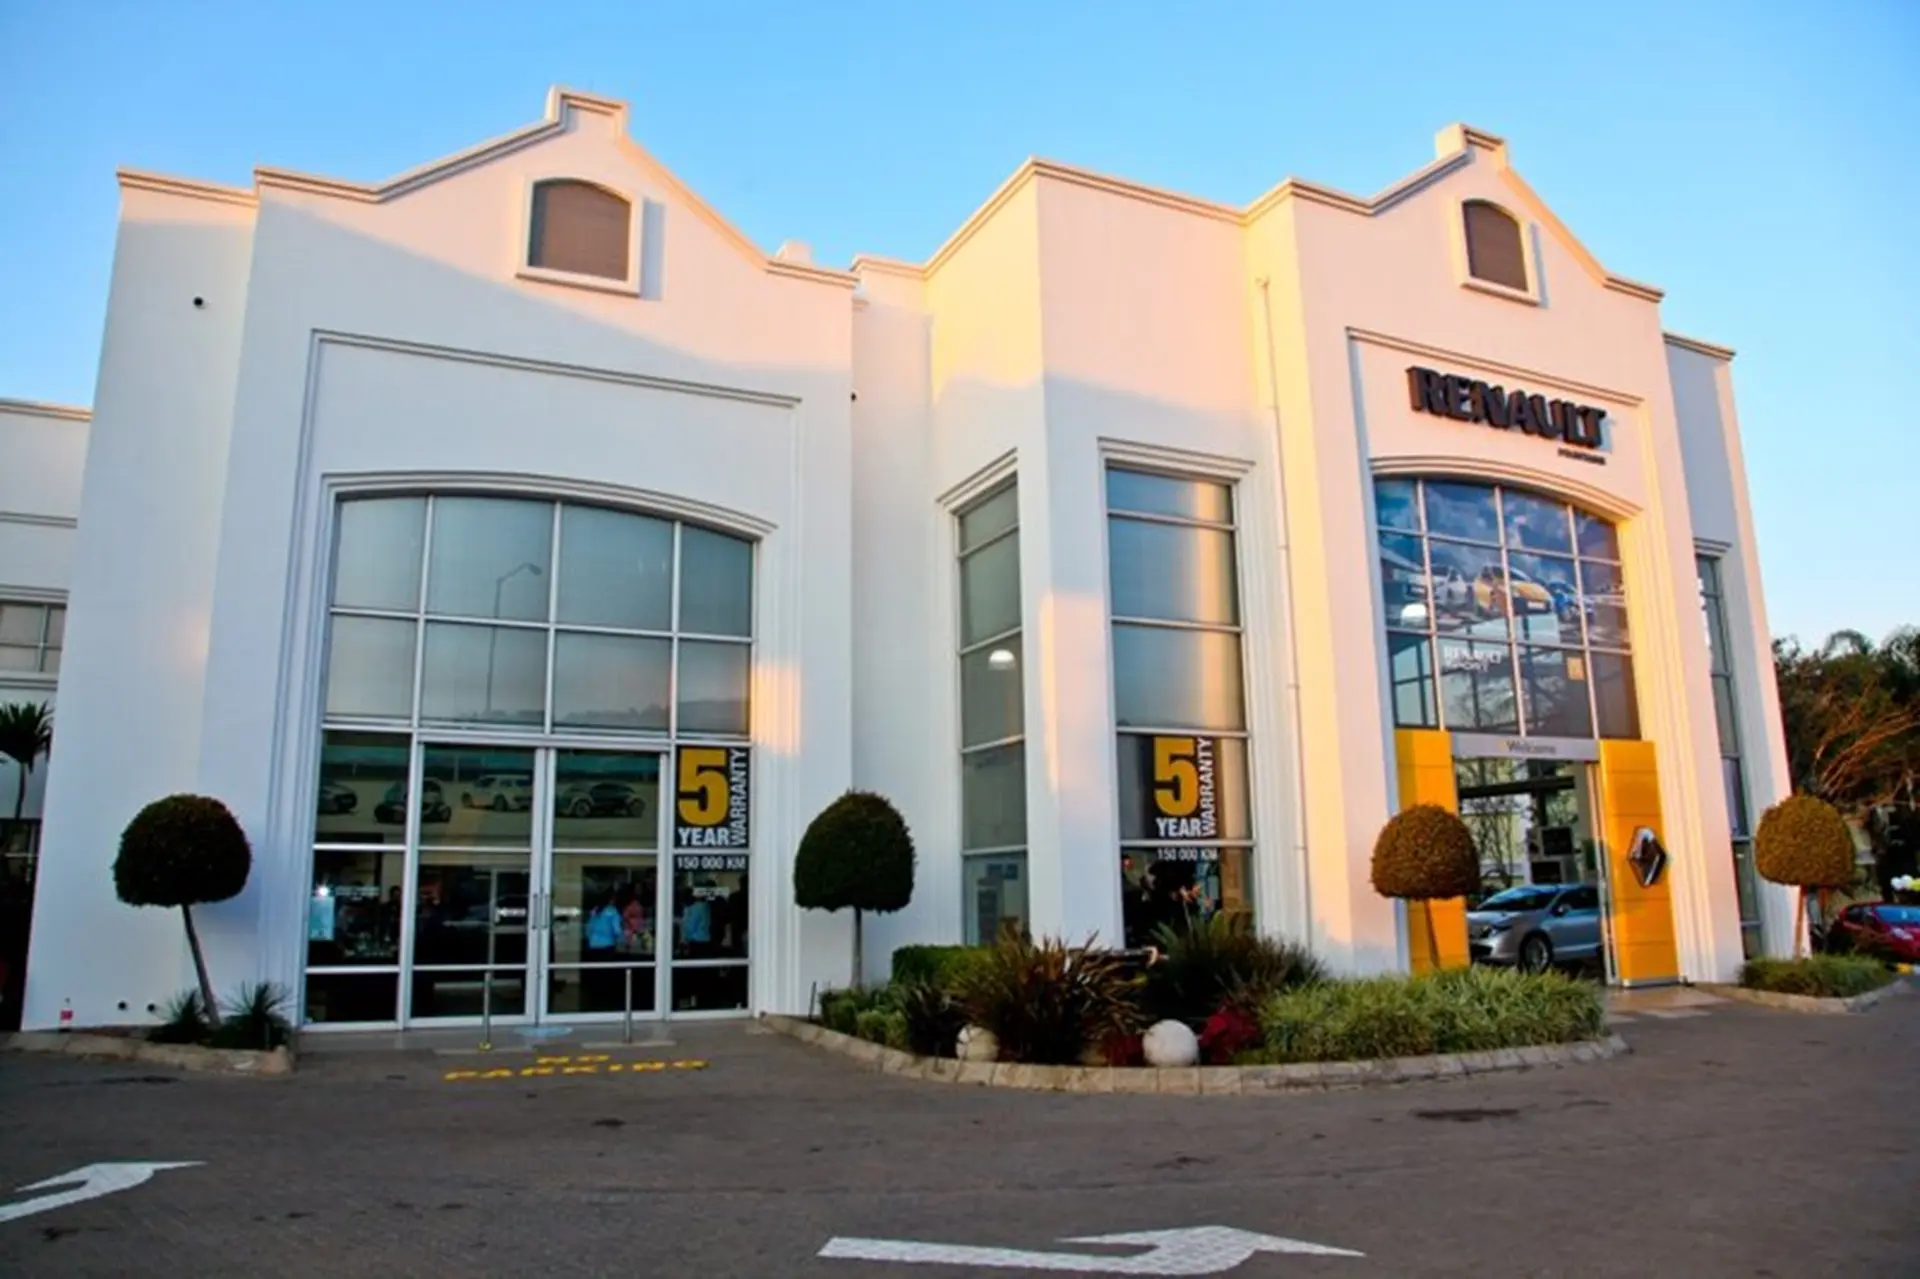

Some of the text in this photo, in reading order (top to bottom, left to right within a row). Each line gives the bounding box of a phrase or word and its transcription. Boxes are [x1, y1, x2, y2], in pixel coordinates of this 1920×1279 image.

[1405, 366, 1607, 447] RENAULT
[678, 748, 728, 826] 5
[730, 748, 747, 846] WARRANTY
[1154, 736, 1198, 817] 5
[1197, 737, 1216, 836] WARRANTY
[678, 827, 729, 846] YEAR
[678, 857, 699, 869] 150
[701, 857, 724, 869] 000
[1156, 818, 1200, 837] YEAR
